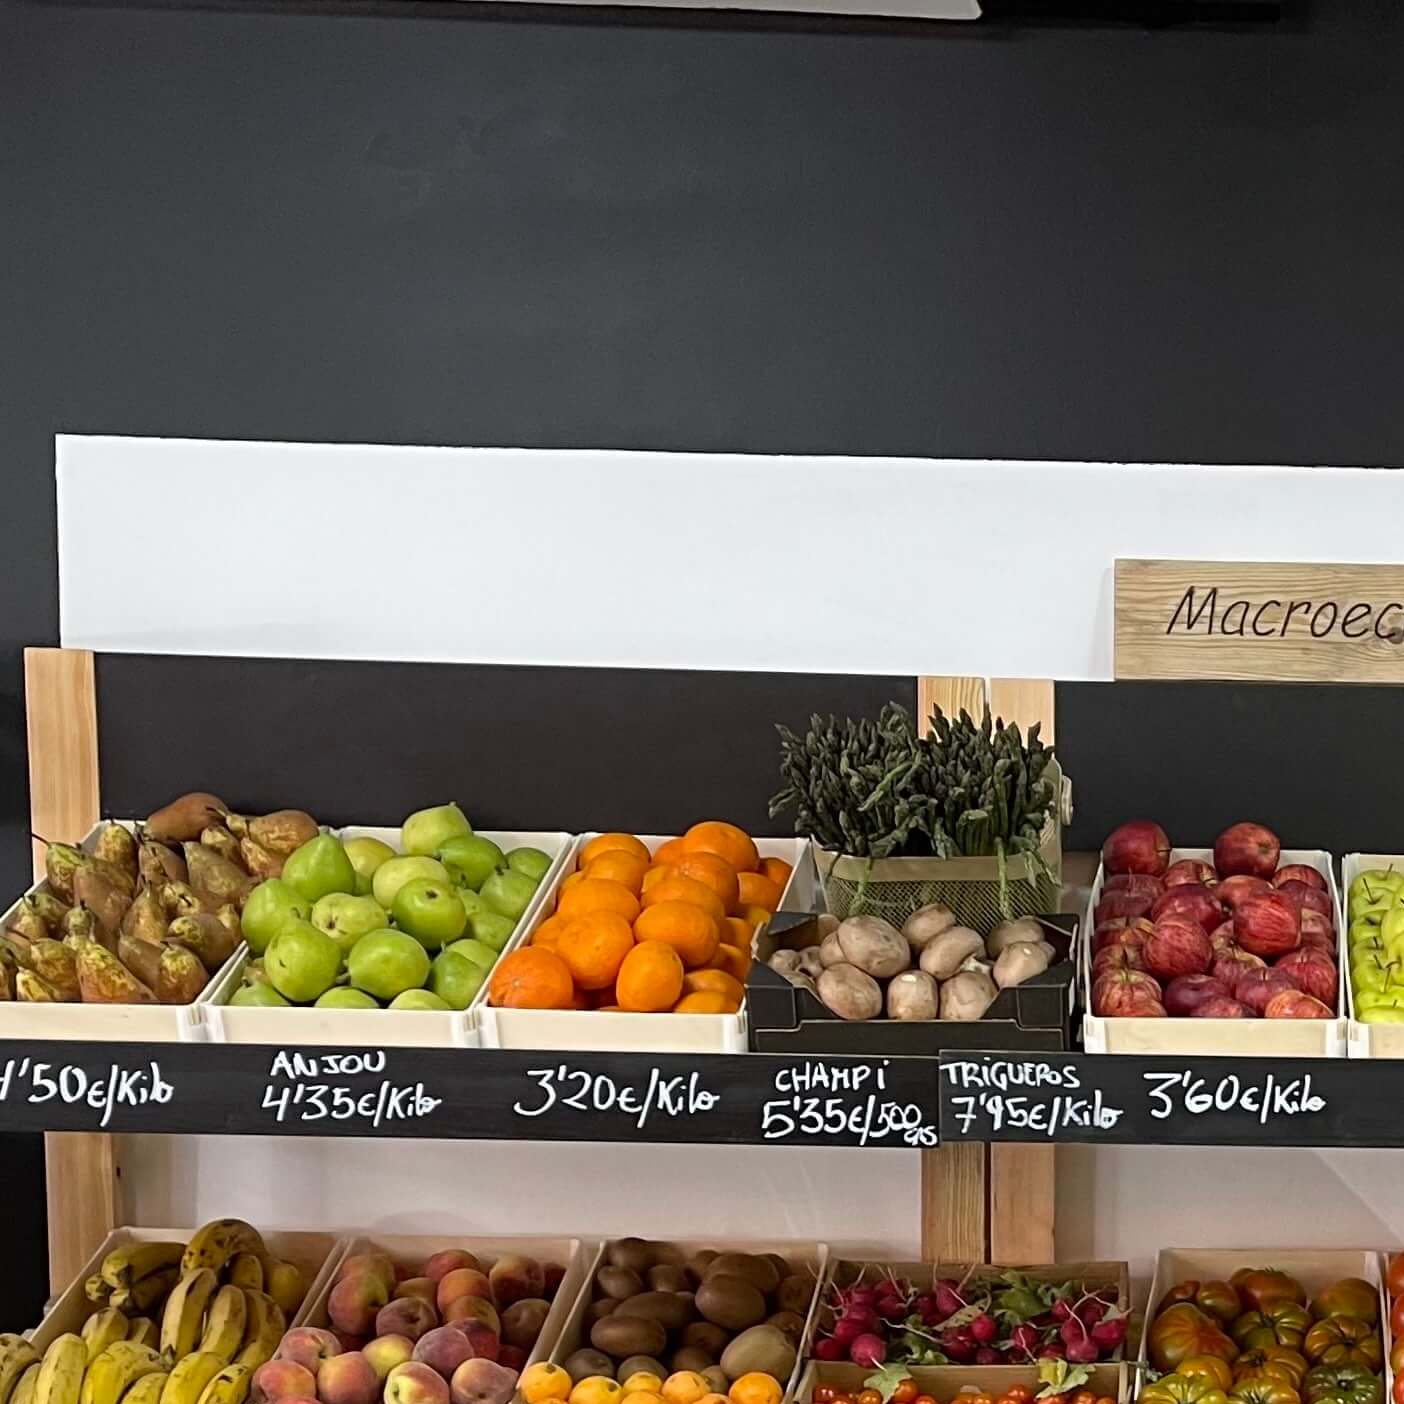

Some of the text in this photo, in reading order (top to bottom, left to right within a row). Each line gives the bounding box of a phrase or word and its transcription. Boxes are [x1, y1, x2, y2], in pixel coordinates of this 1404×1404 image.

[270, 1050, 386, 1079] ANJOU
[261, 1080, 443, 1128] 4'35€/Kilo
[513, 1064, 721, 1129] 3'20€/Kilo
[951, 1089, 1124, 1136] 7'95€/Kilo
[1143, 1070, 1326, 1124] 3'60€/Kilo
